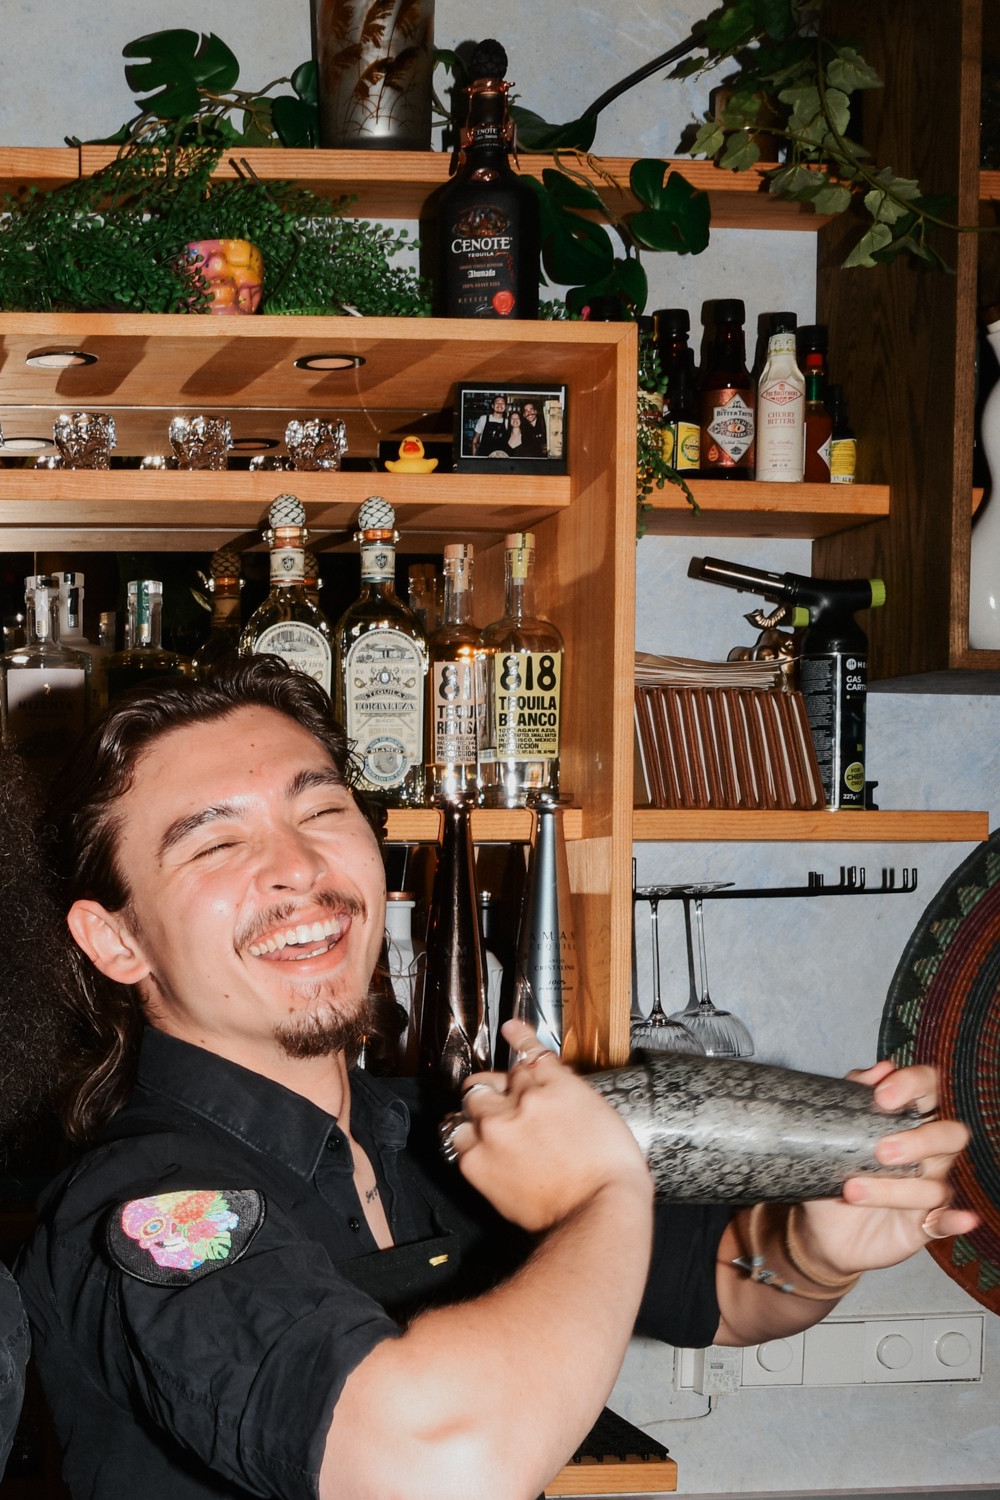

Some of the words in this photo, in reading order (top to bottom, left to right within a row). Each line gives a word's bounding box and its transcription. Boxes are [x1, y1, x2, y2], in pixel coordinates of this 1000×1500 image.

[451, 236, 511, 254] CENOTE
[767, 411, 795, 419] CHERRY
[500, 655, 557, 692] 818
[846, 675, 862, 683] GAS
[355, 702, 415, 711] FORTALEZA
[499, 712, 557, 727] BANCO
